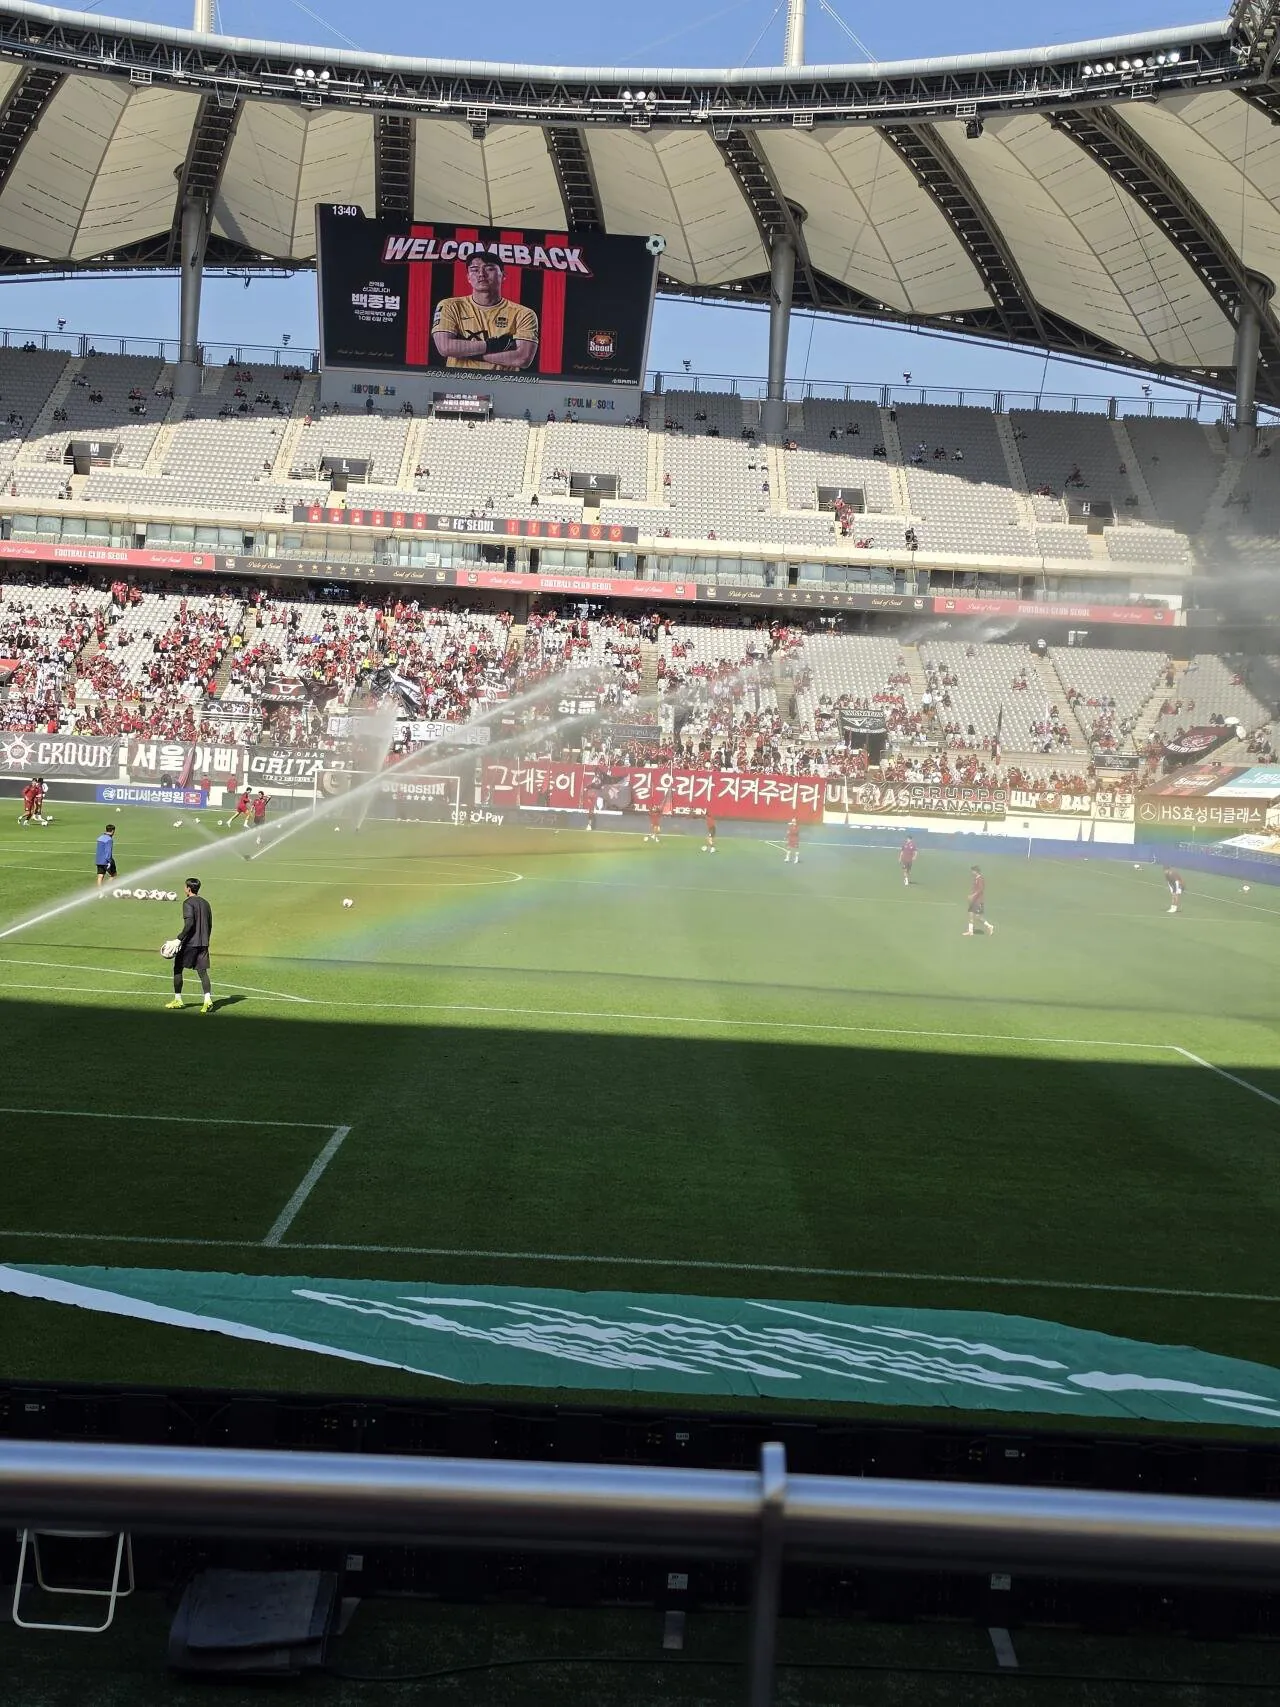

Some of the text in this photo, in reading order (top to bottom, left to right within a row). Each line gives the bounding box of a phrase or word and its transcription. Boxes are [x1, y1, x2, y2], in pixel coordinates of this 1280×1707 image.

[332, 205, 357, 216] 13:40
[351, 293, 401, 310] 백종범
[425, 370, 450, 378] SEOUL
[454, 372, 481, 380] WORLD
[502, 375, 539, 383] STADIUM
[90, 443, 100, 453] M
[342, 459, 350, 469] L
[590, 475, 598, 485] K
[1083, 502, 1091, 512] H
[453, 519, 464, 531] FC
[467, 519, 495, 533] SEOUL
[54, 548, 129, 561] FOOTBALL CLUB SEOUL
[540, 578, 613, 591] FOOTBALL CLUB SEOUL
[1017, 605, 1090, 617] FOOTBALL CLUB SEOUL
[38, 742, 112, 767] CROWN
[117, 788, 184, 804] 마디세상병원
[632, 772, 652, 799] 길
[655, 773, 715, 802] 우리가
[718, 777, 821, 812] 지켜주리라
[911, 786, 1006, 801] GRUPPO
[910, 798, 1006, 813] THANATOS
[486, 812, 504, 826] Pay
